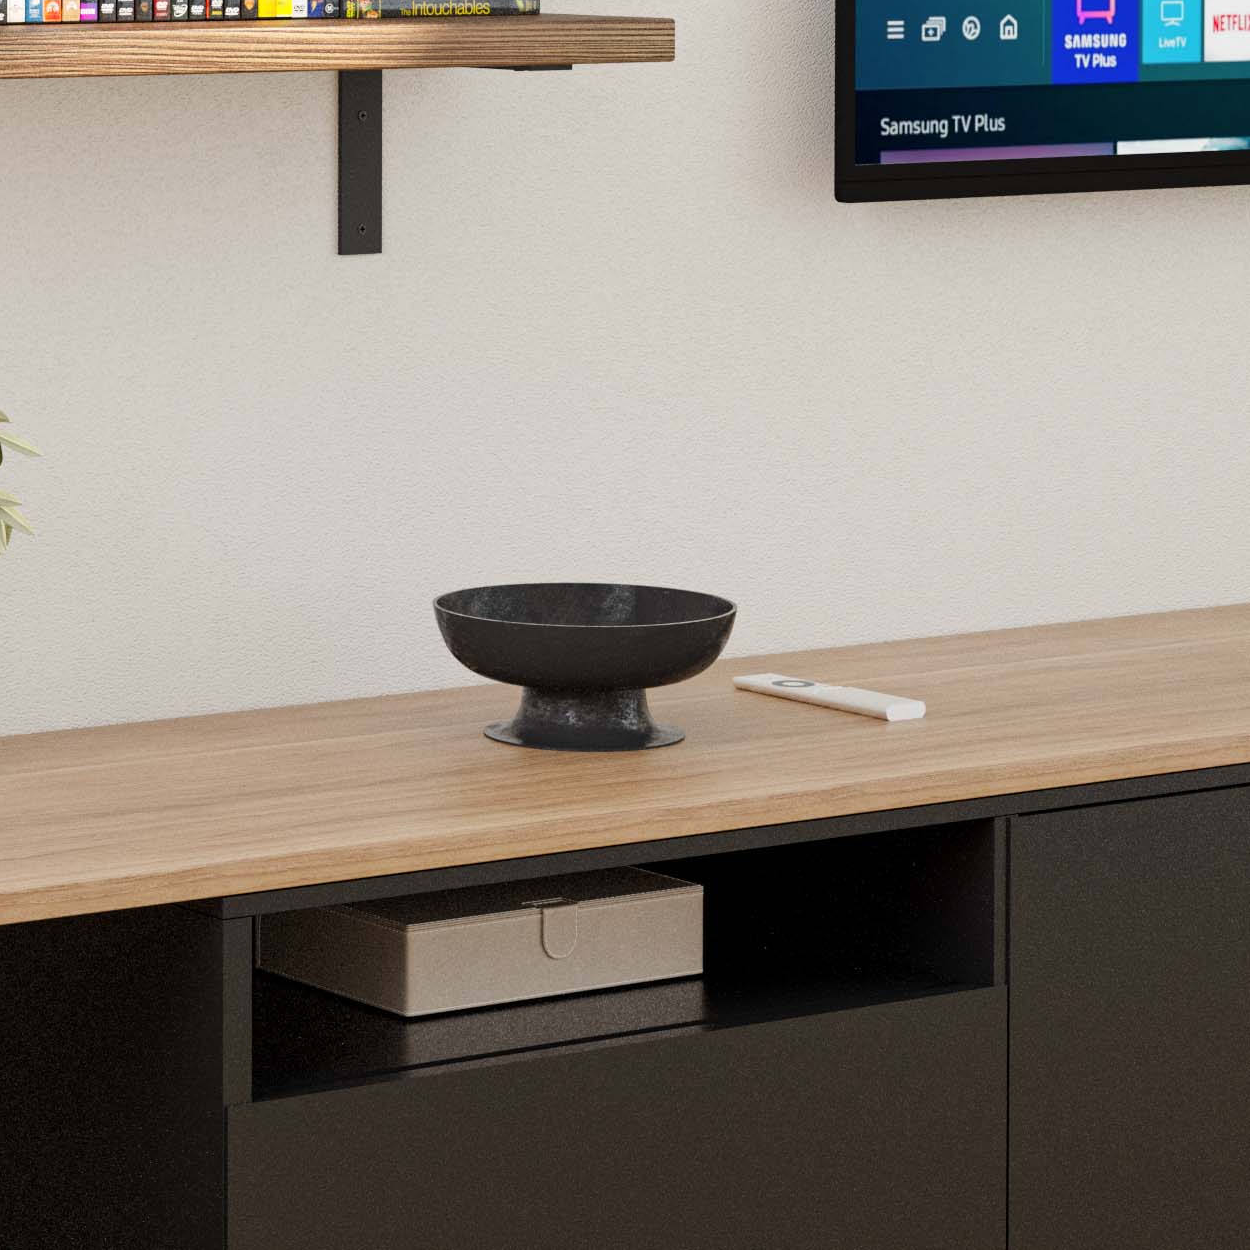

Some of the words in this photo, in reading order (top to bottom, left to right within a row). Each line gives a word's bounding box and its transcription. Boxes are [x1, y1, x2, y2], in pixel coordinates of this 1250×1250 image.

[401, 7, 411, 16] The
[412, 0, 491, 16] Intouchables
[1064, 32, 1128, 49] SAMSUNG
[1074, 53, 1091, 68] TV
[1092, 52, 1117, 67] Plus
[880, 117, 949, 138] Samsung
[952, 116, 972, 133] TV
[975, 113, 1006, 132] Plus
